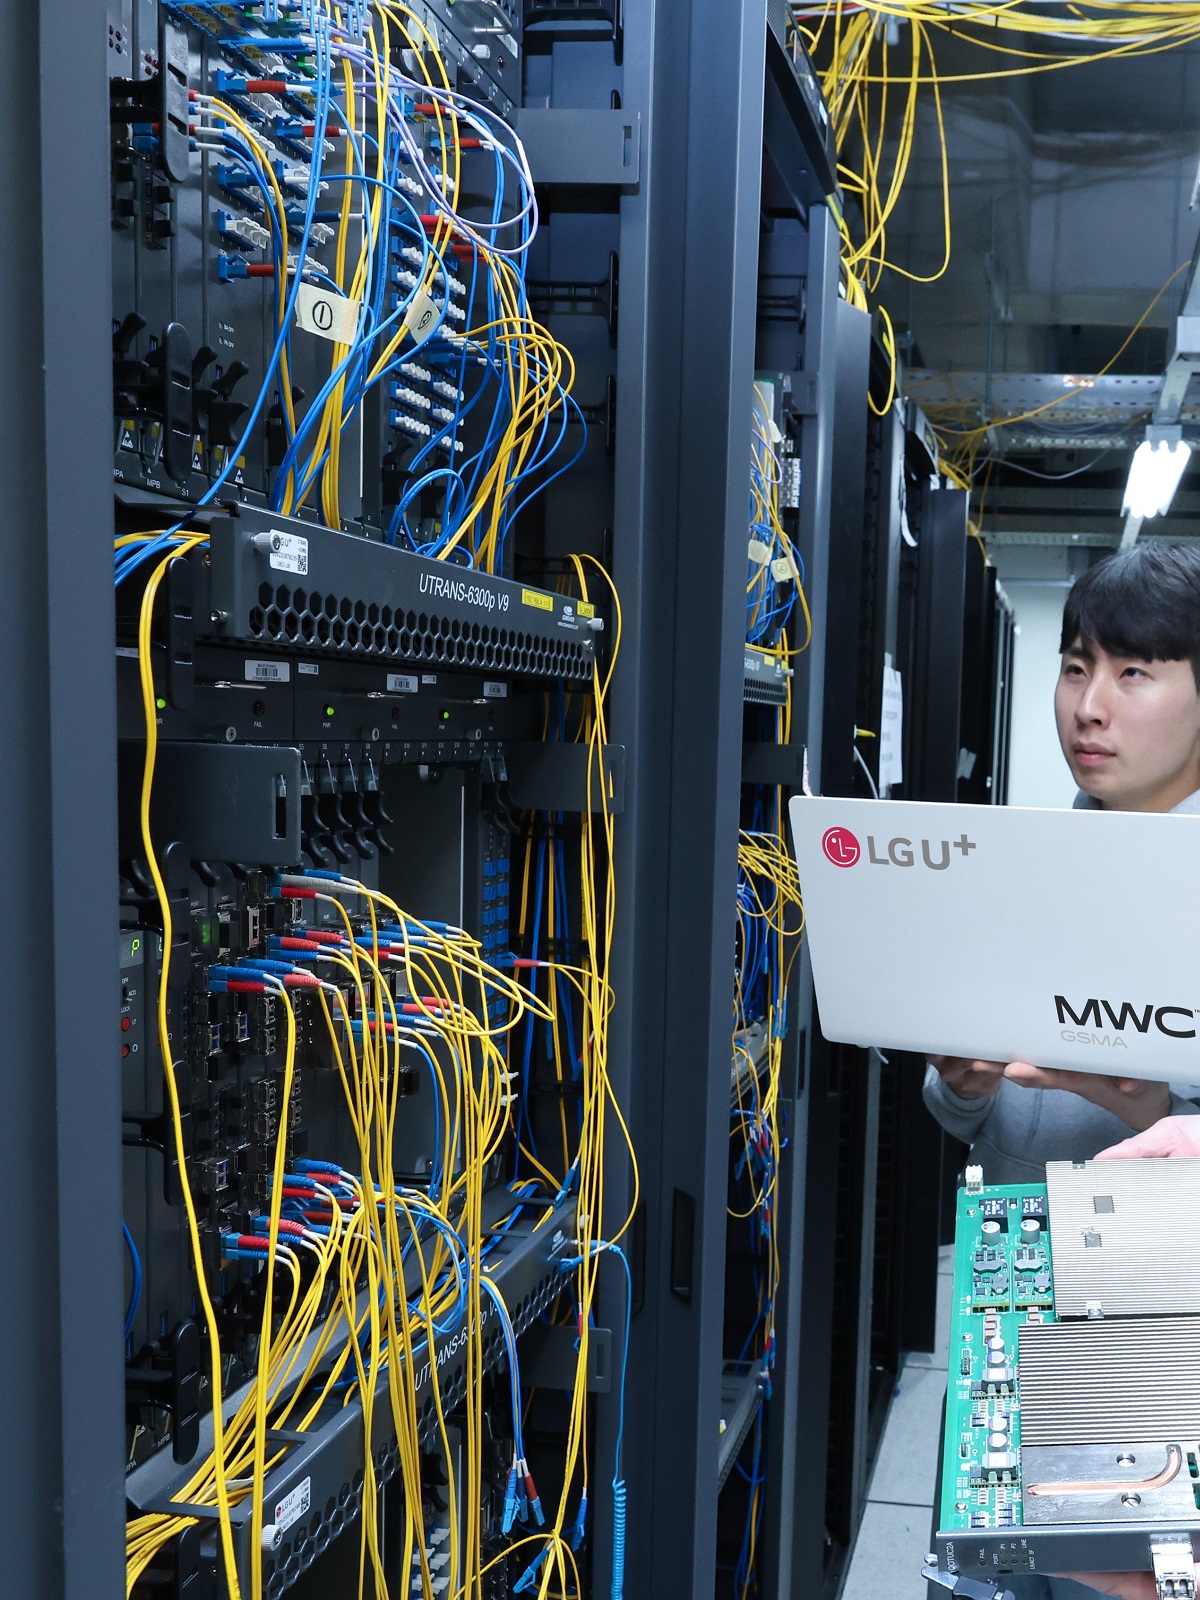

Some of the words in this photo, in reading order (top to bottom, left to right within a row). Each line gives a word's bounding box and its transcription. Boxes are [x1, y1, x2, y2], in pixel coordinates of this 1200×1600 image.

[146, 478, 161, 489] MPB
[181, 488, 189, 497] S1
[419, 572, 496, 612] UTRANS-6300p
[497, 592, 510, 612] V9
[867, 835, 915, 868] LG
[921, 833, 977, 871] U+
[120, 1005, 131, 1014] LOCK
[1053, 994, 1197, 1039] MWC
[1060, 1029, 1129, 1049] GSMA
